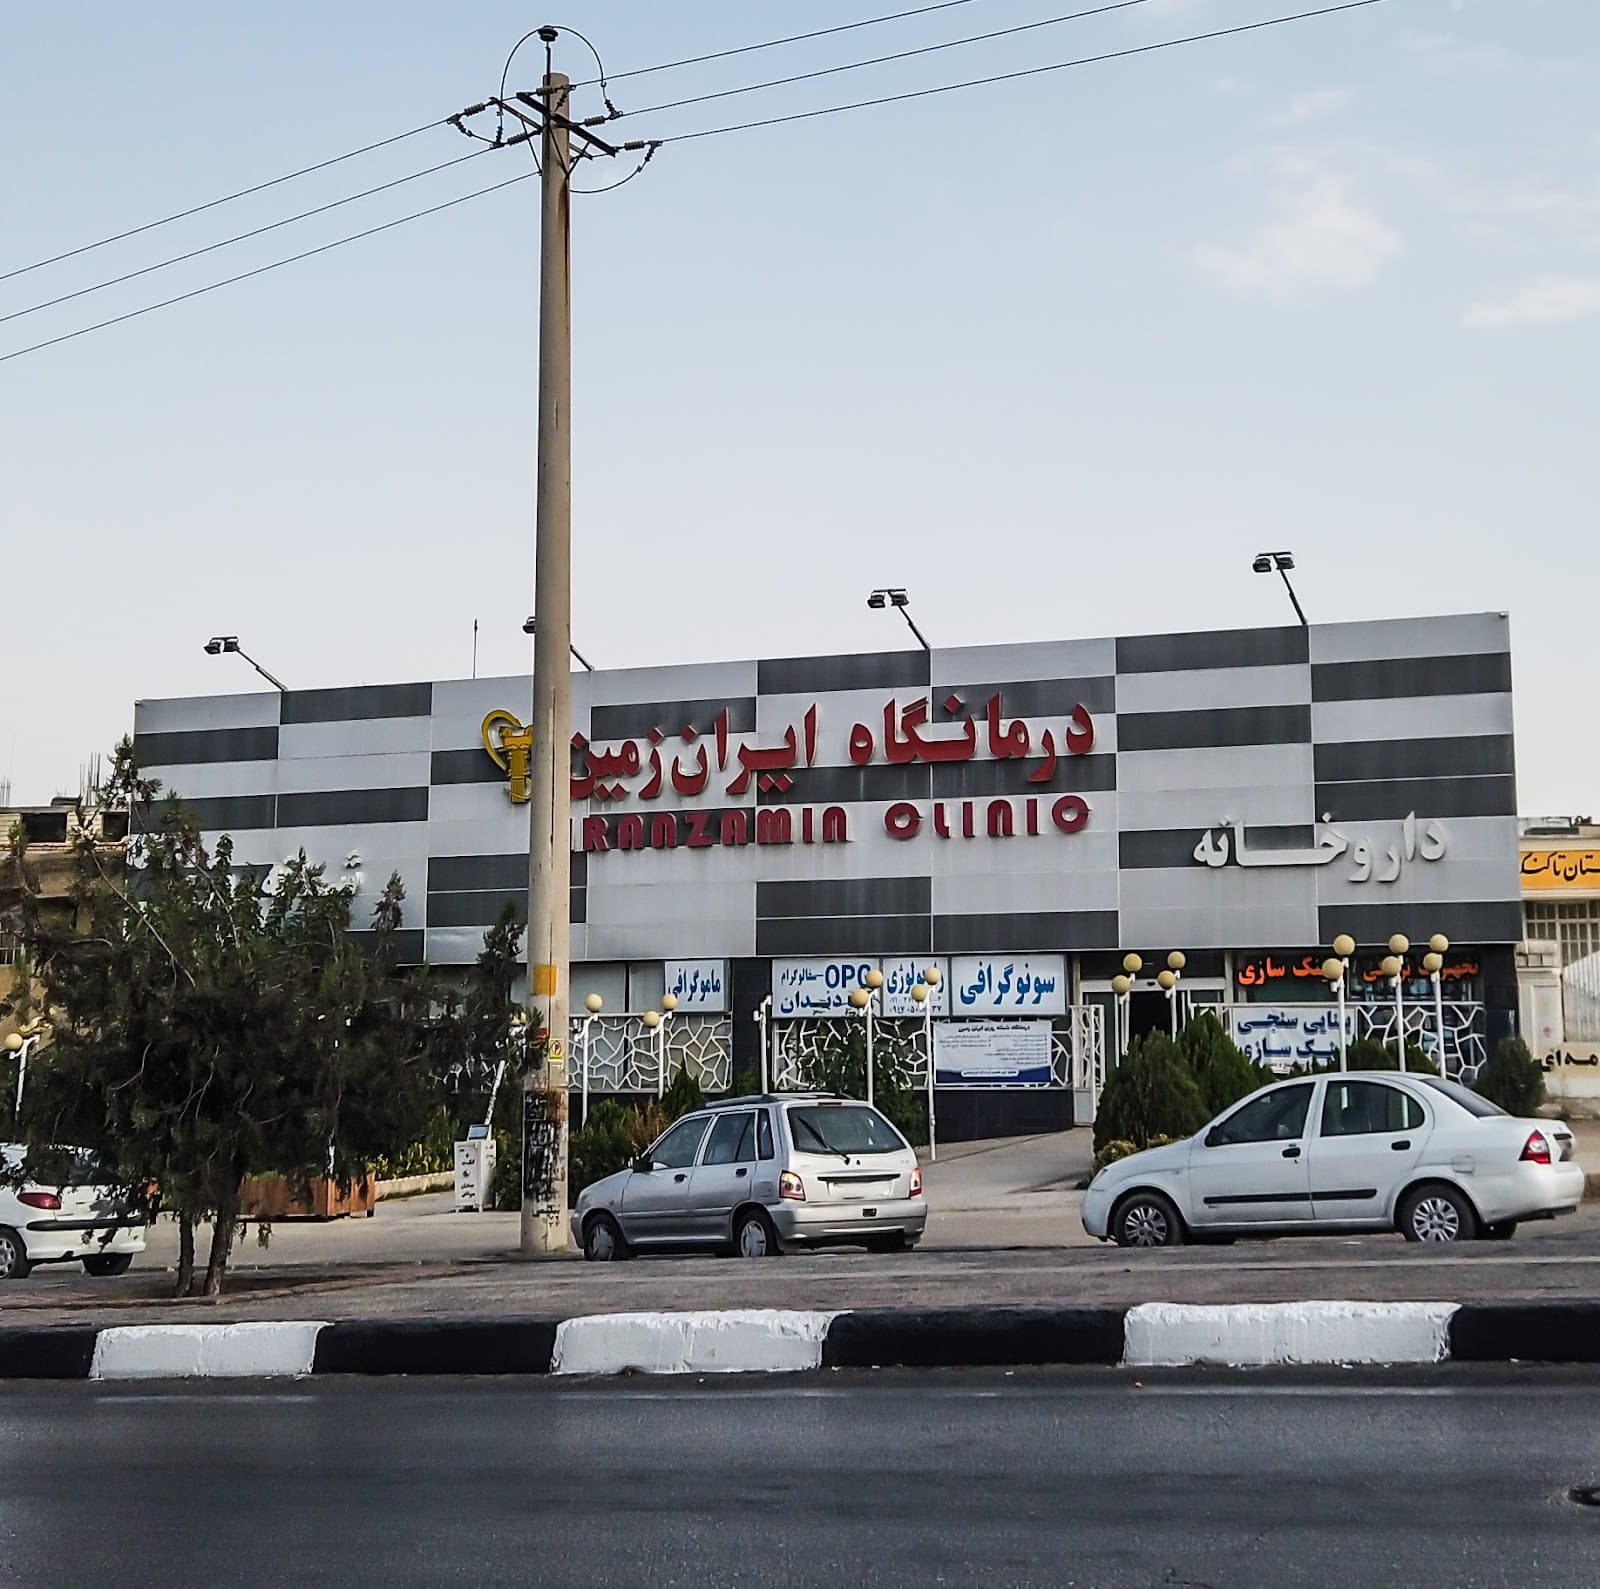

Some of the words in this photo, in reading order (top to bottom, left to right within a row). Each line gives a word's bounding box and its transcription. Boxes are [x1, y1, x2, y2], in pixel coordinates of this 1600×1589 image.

[671, 700, 820, 796] ایران
[847, 692, 1096, 783] درمانگاه
[883, 794, 1092, 841] CLINIC
[1193, 810, 1446, 883] داروخانه
[959, 960, 1056, 1006] سونوگرافی
[1238, 956, 1286, 985] سازی
[1237, 1011, 1298, 1035] سنجی
[1303, 1010, 1351, 1035] بنایی
